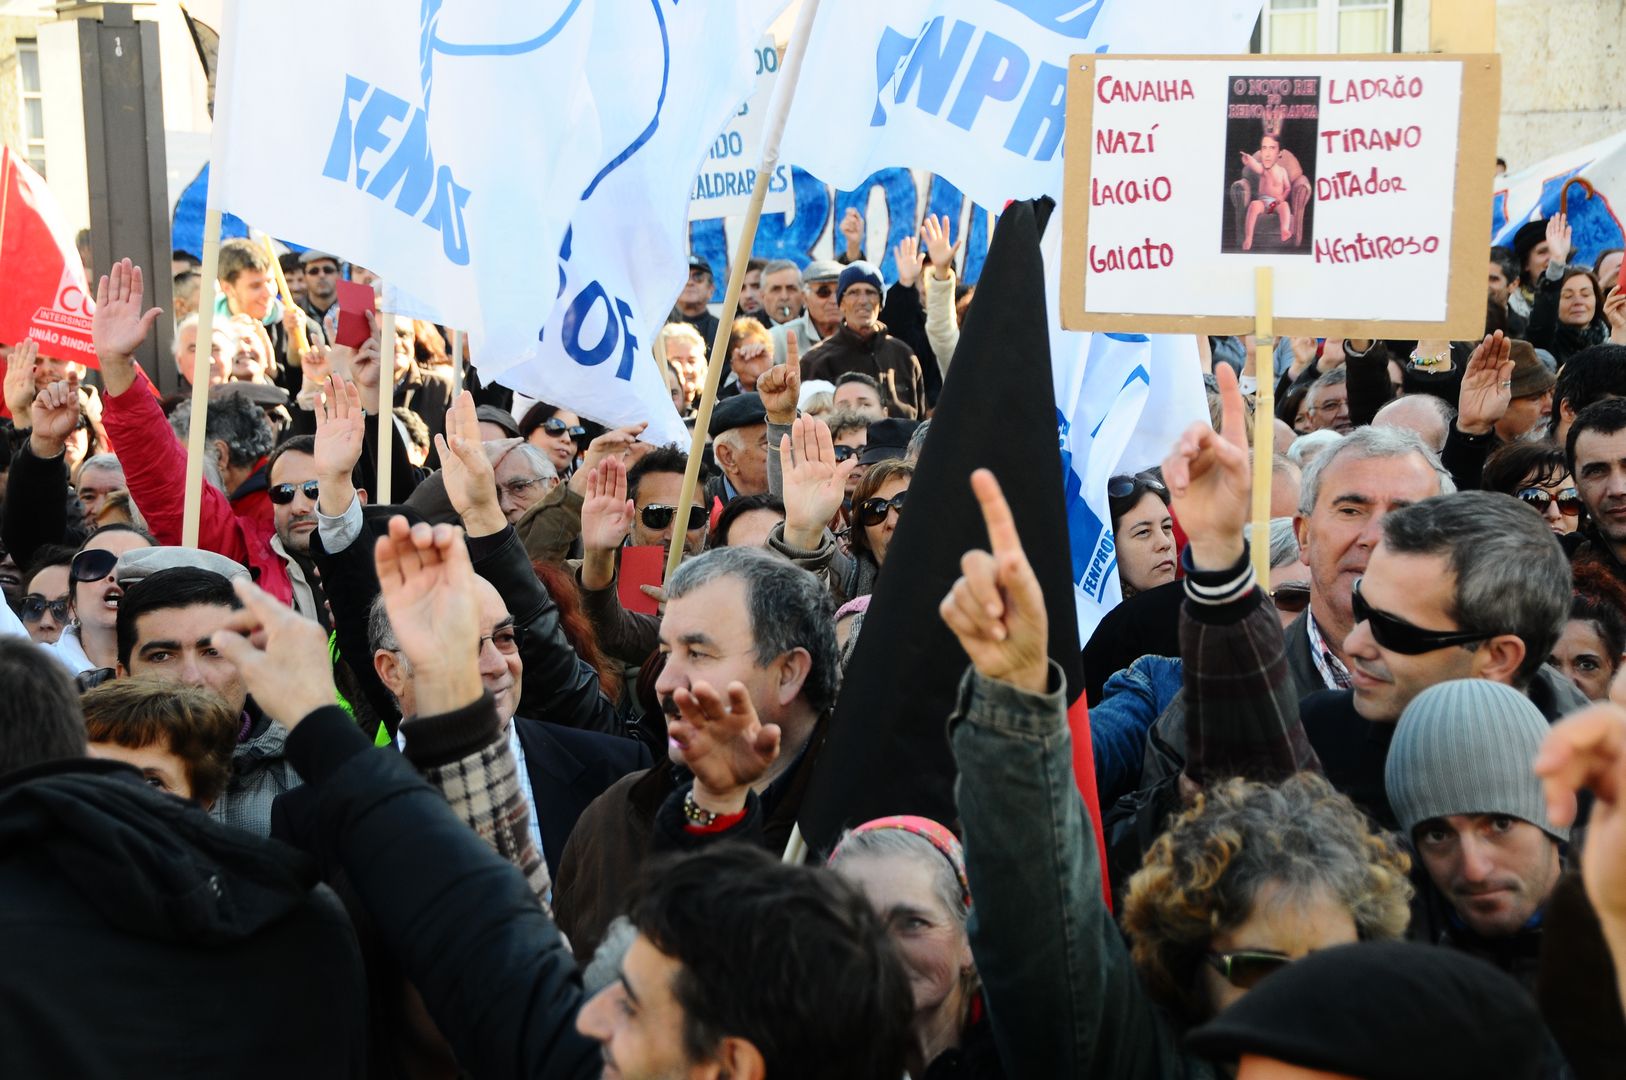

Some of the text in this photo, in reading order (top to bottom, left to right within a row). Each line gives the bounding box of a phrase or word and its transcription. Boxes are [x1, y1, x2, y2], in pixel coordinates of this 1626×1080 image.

[1097, 75, 1195, 104] CANALHA
[1233, 79, 1247, 96] O
[1248, 79, 1292, 96] NOVO
[1097, 123, 1159, 155] NAZÍ
[691, 165, 788, 200] ALDRABES
[40, 309, 93, 329] INTERSINDI
[60, 334, 97, 354] SINDIC
[1082, 529, 1115, 598] FENPROF
